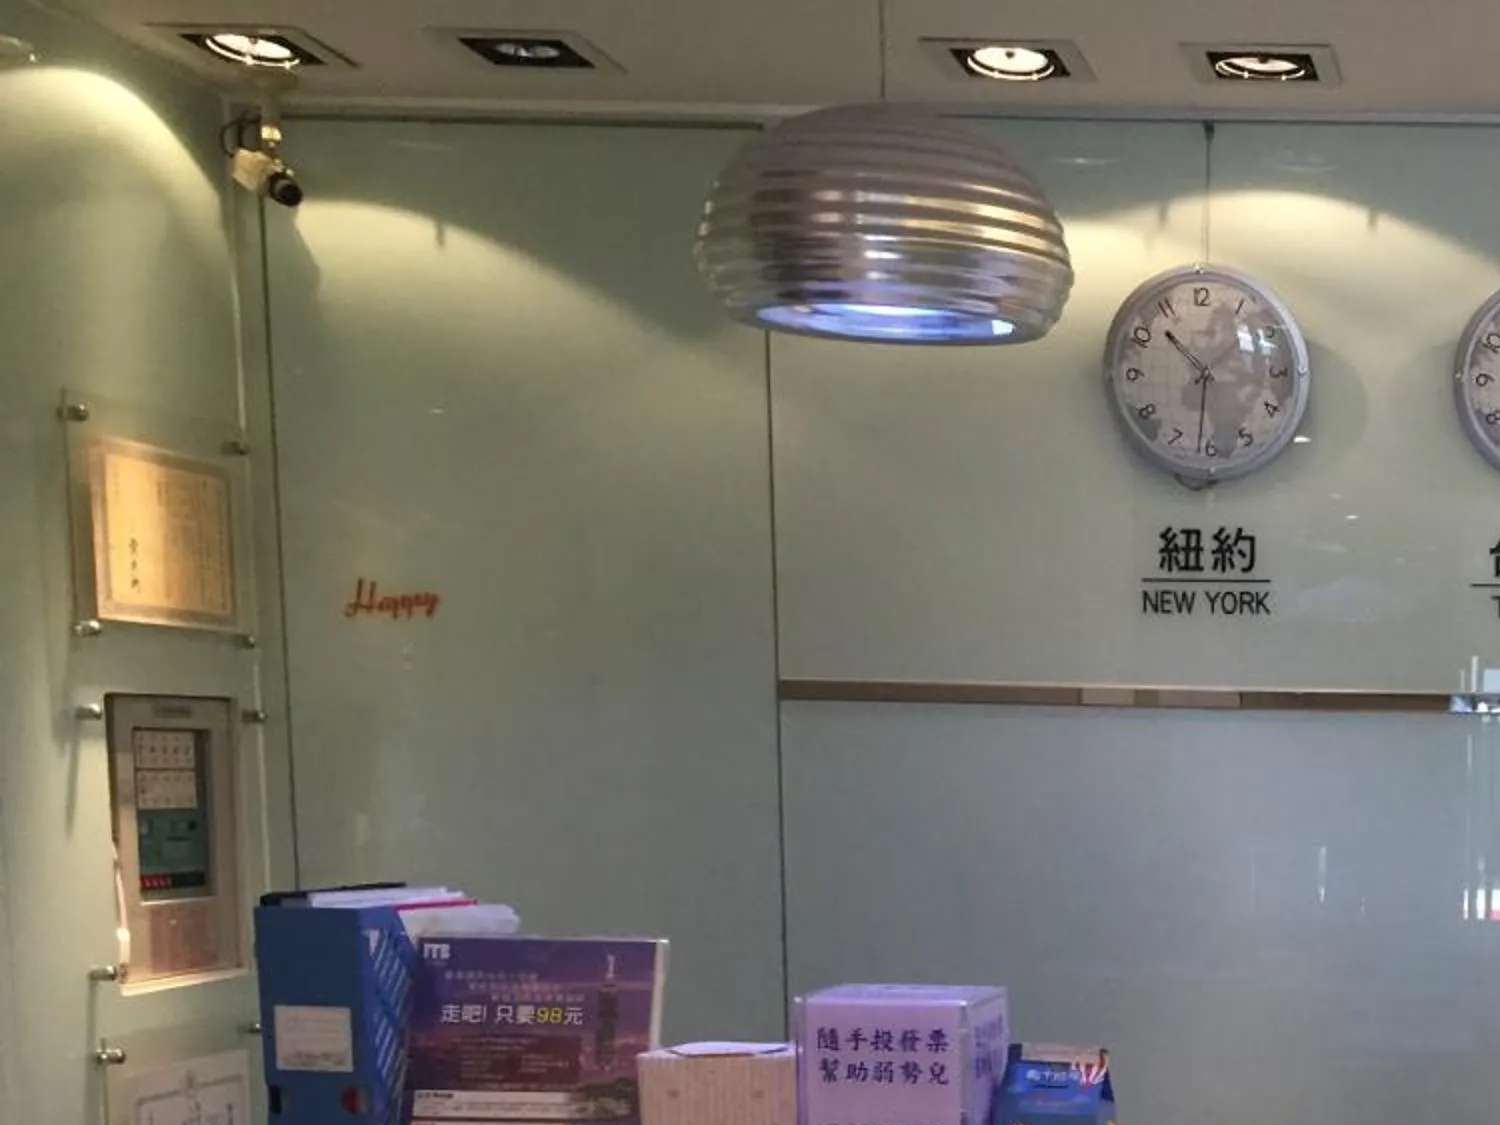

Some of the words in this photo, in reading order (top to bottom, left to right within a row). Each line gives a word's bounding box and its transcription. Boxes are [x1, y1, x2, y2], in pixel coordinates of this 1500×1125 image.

[1193, 288, 1209, 306] 12
[1235, 298, 1244, 314] 1
[1158, 298, 1175, 318] 11
[1134, 326, 1151, 348] 10
[1126, 367, 1144, 382] 9
[1270, 367, 1287, 378] 3
[1476, 373, 1494, 387] 9
[1138, 403, 1156, 419] 8
[1264, 400, 1280, 418] 4
[1168, 428, 1183, 445] 7
[1238, 427, 1253, 446] 5
[1205, 440, 1217, 457] 6
[1159, 526, 1256, 573] 紐約
[344, 577, 439, 620] Happy
[1142, 590, 1196, 615] NEW
[1204, 590, 1271, 615] YORK
